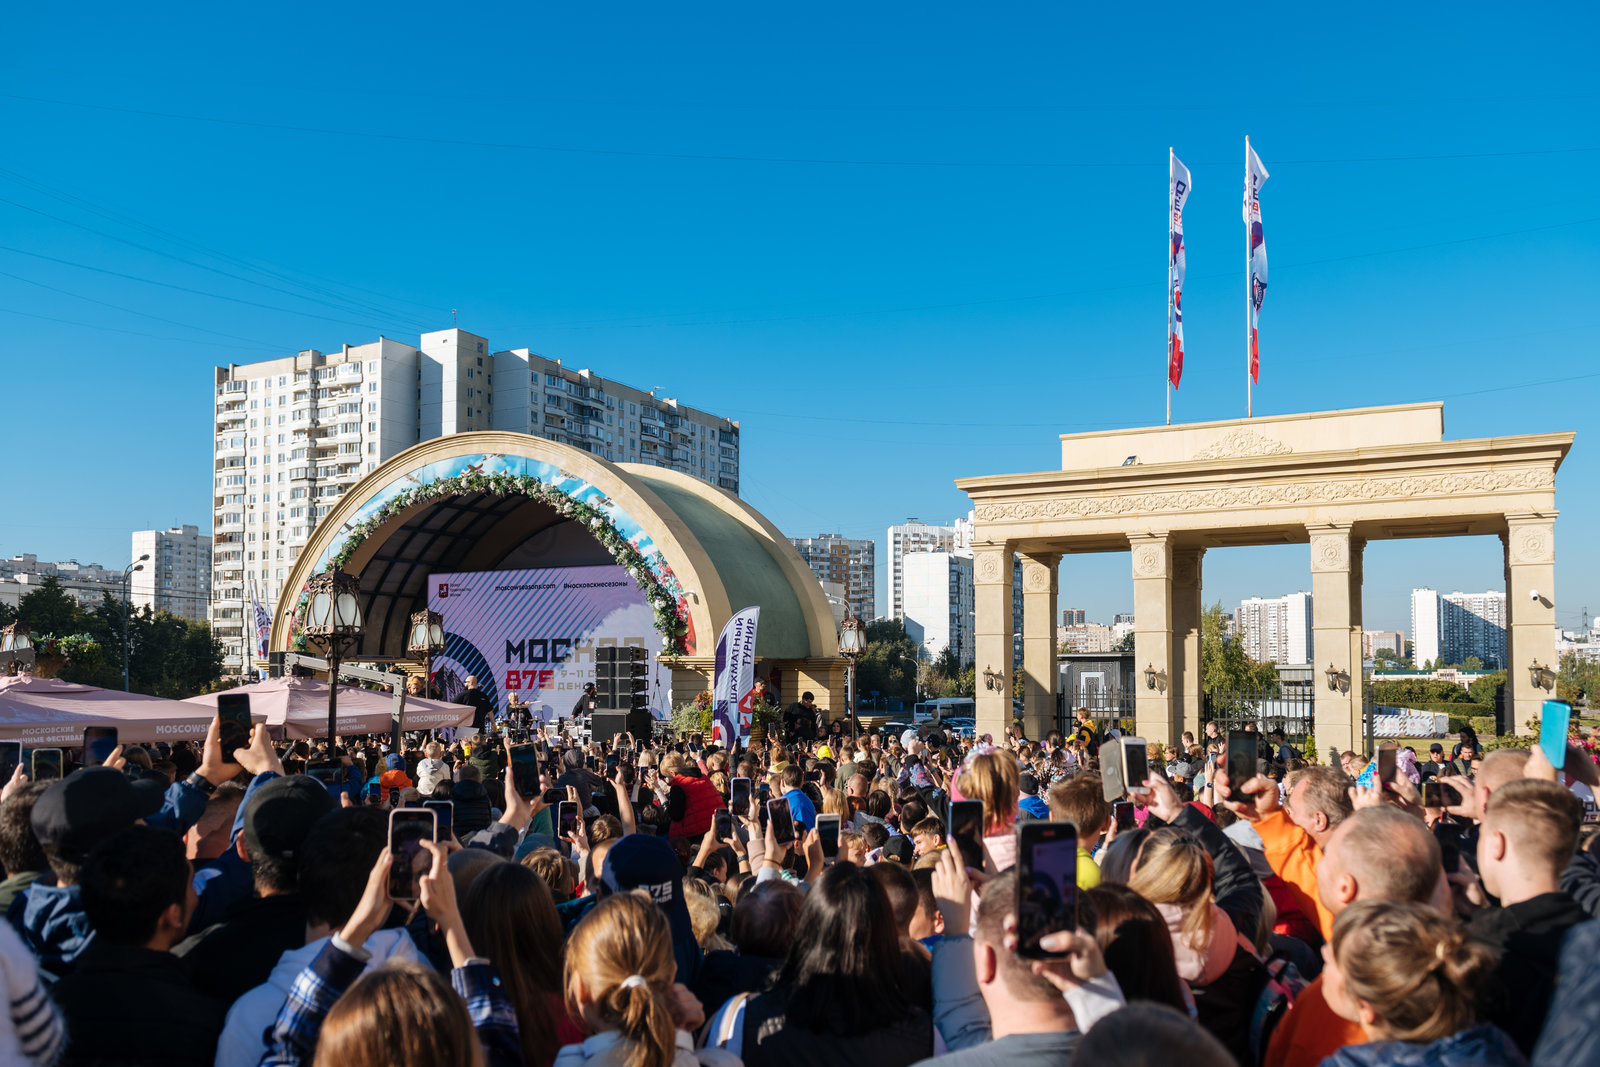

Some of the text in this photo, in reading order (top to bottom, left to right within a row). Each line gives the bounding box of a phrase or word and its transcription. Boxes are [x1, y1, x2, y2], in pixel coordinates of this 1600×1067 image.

[494, 583, 556, 591] moscowseasons.com
[742, 618, 755, 666] ТУРНИР
[730, 617, 744, 703] ШАХМАТНЫЙ
[505, 670, 555, 690] 875
[406, 714, 460, 723] MOSCOWSEASONS
[22, 726, 75, 735] МОСКОВСКИЕ
[155, 724, 209, 734] MOSCOWS
[46, 734, 84, 743] ФЕСТИВАЛ
